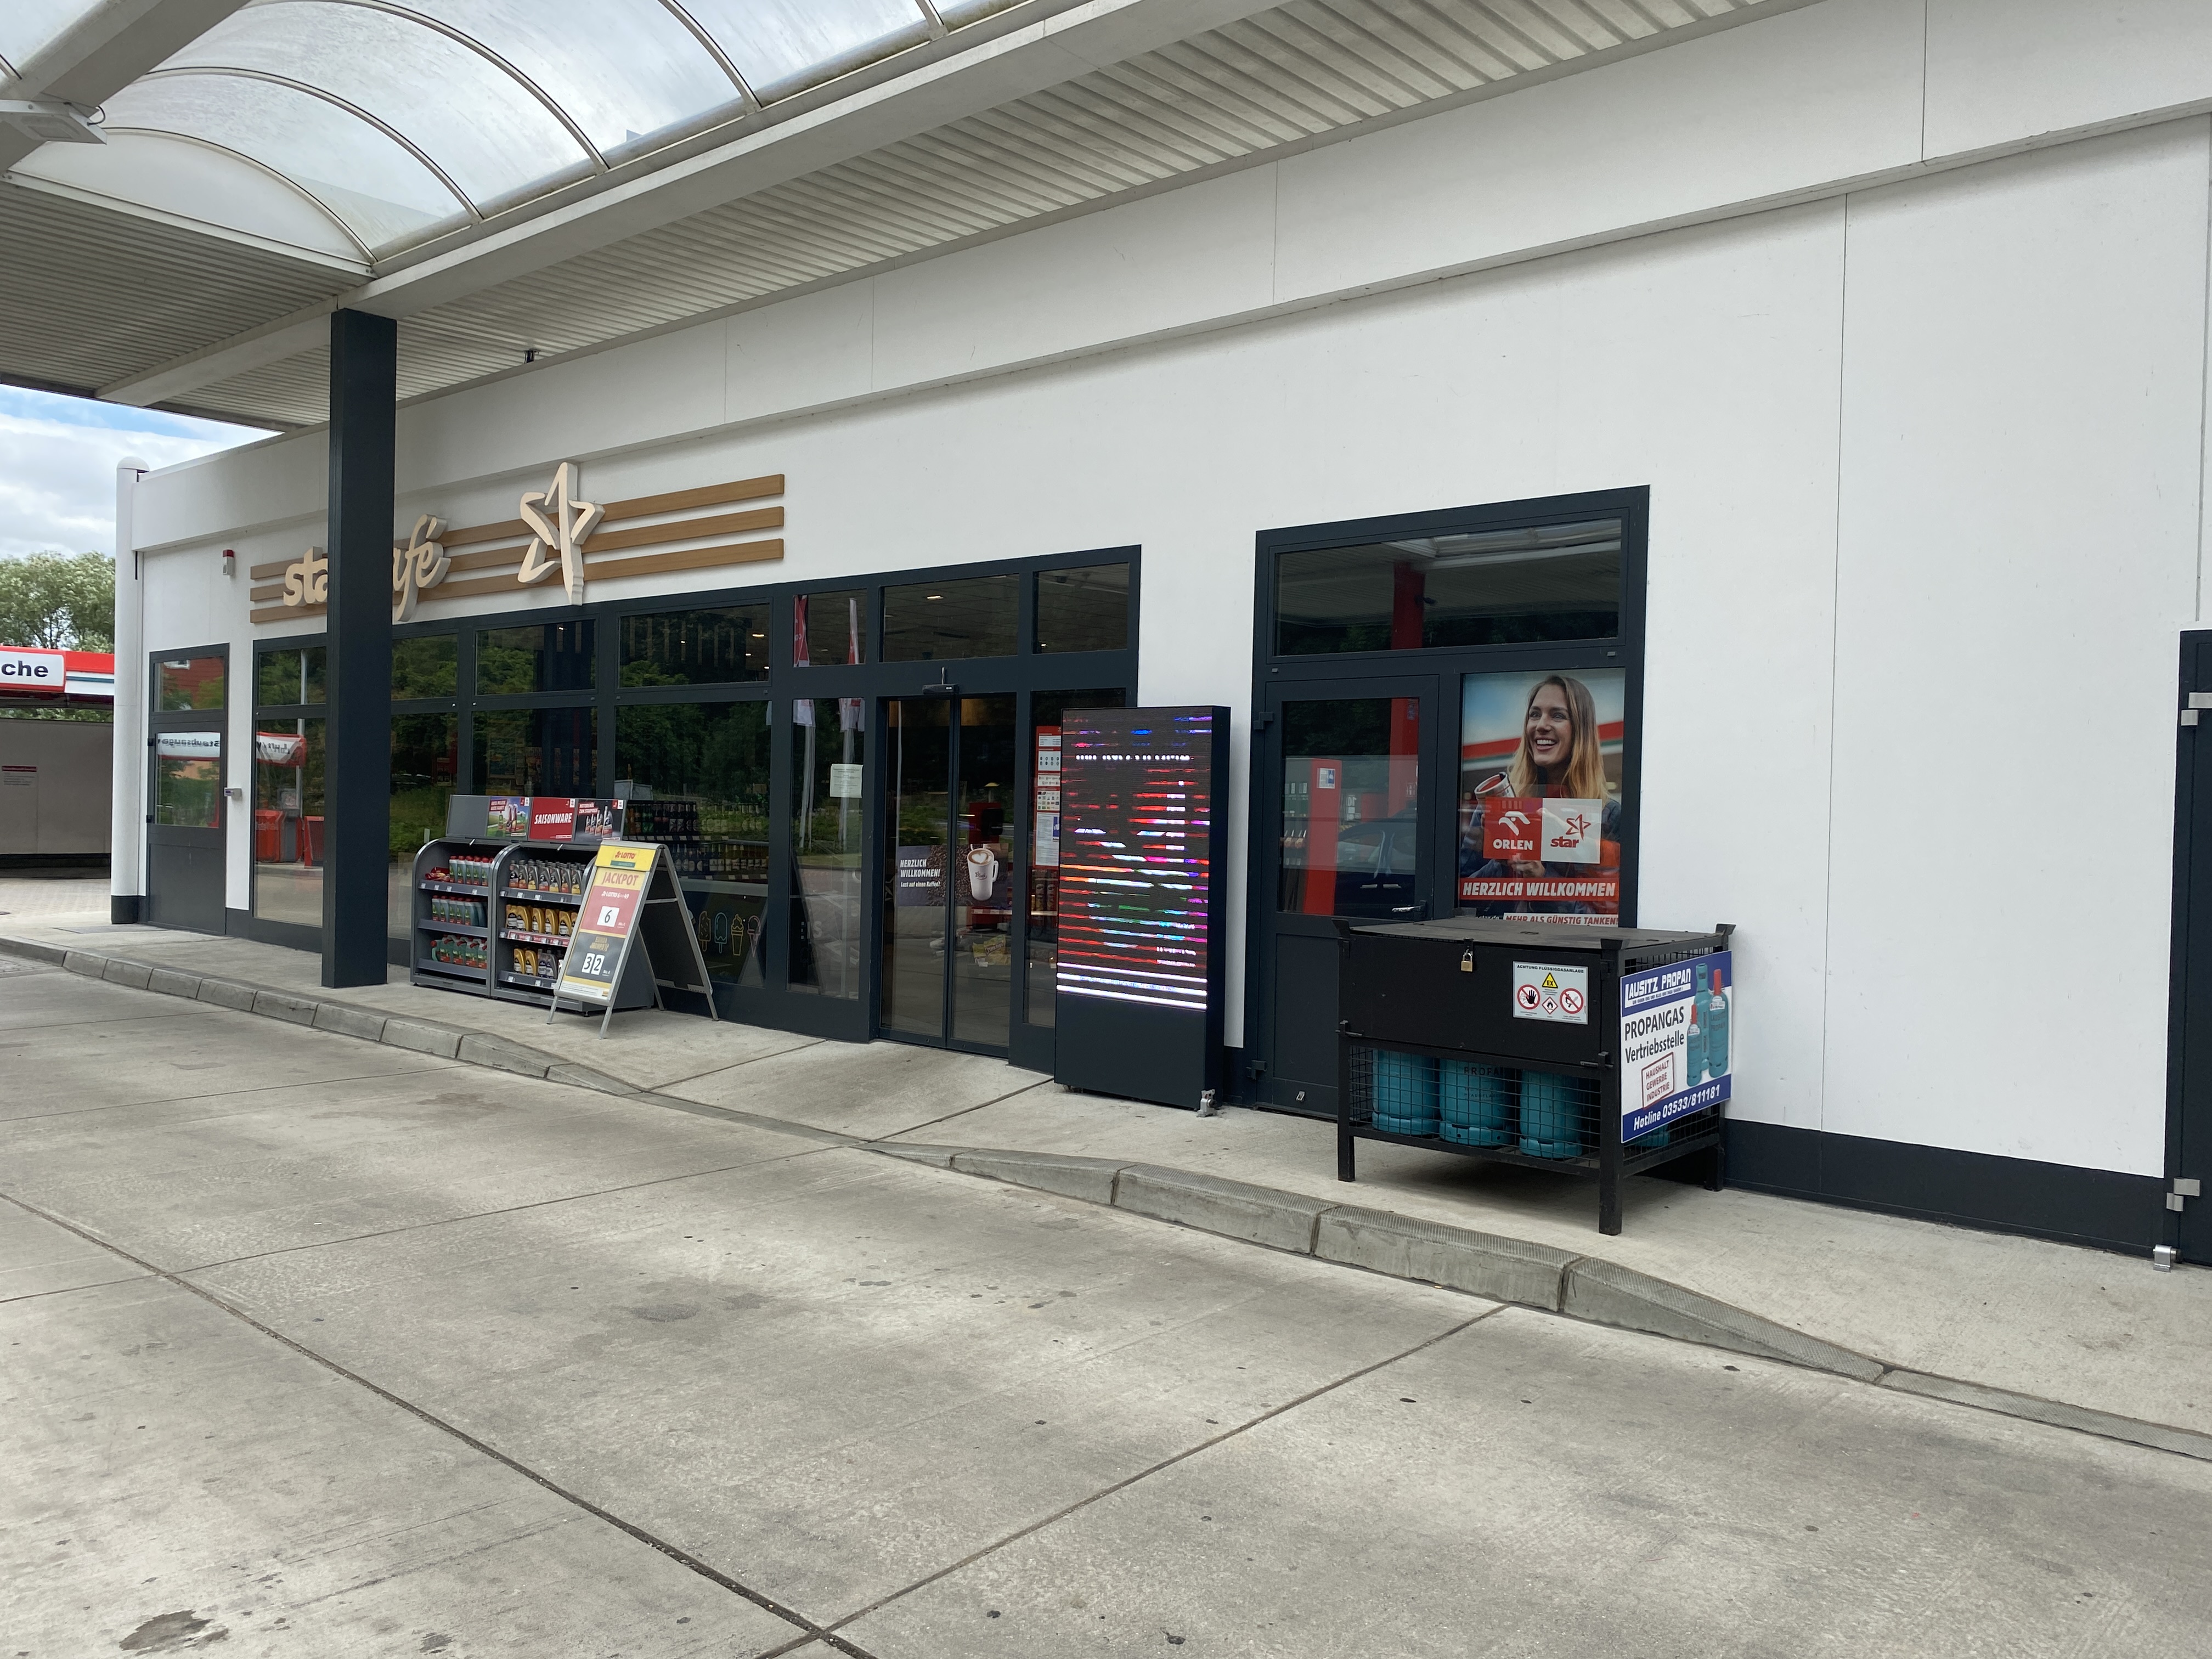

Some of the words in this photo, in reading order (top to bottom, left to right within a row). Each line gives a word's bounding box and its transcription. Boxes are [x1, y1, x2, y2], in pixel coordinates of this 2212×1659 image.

[1, 660, 49, 678] che
[534, 813, 573, 825] SAISONWARE
[1493, 838, 1533, 850] ORLEN
[1550, 836, 1579, 848] star
[900, 859, 927, 868] HERZLICH
[601, 872, 639, 886] JACKPOT
[900, 868, 941, 878] WILLKOMMEN!
[1463, 882, 1523, 896] HERZLICH
[1526, 882, 1616, 897] WILLKOMMEN
[605, 910, 612, 923] 6
[1547, 915, 1581, 924] GÜNSTIG
[584, 956, 602, 972] 32
[1625, 977, 1658, 1008] LAUSITZ
[1661, 968, 1691, 990] PROPAN
[1624, 1006, 1684, 1041] PROPANGAS
[1625, 1030, 1684, 1064] Vertriebsstelle
[1464, 1067, 1504, 1076] PROPA
[1646, 1059, 1669, 1080] HAUSHALT
[1646, 1071, 1668, 1091] GEWERBE
[1646, 1081, 1670, 1102] INDUSTRIE
[1633, 1109, 1661, 1131] Hotline
[1662, 1084, 1720, 1119] 03533/811181
